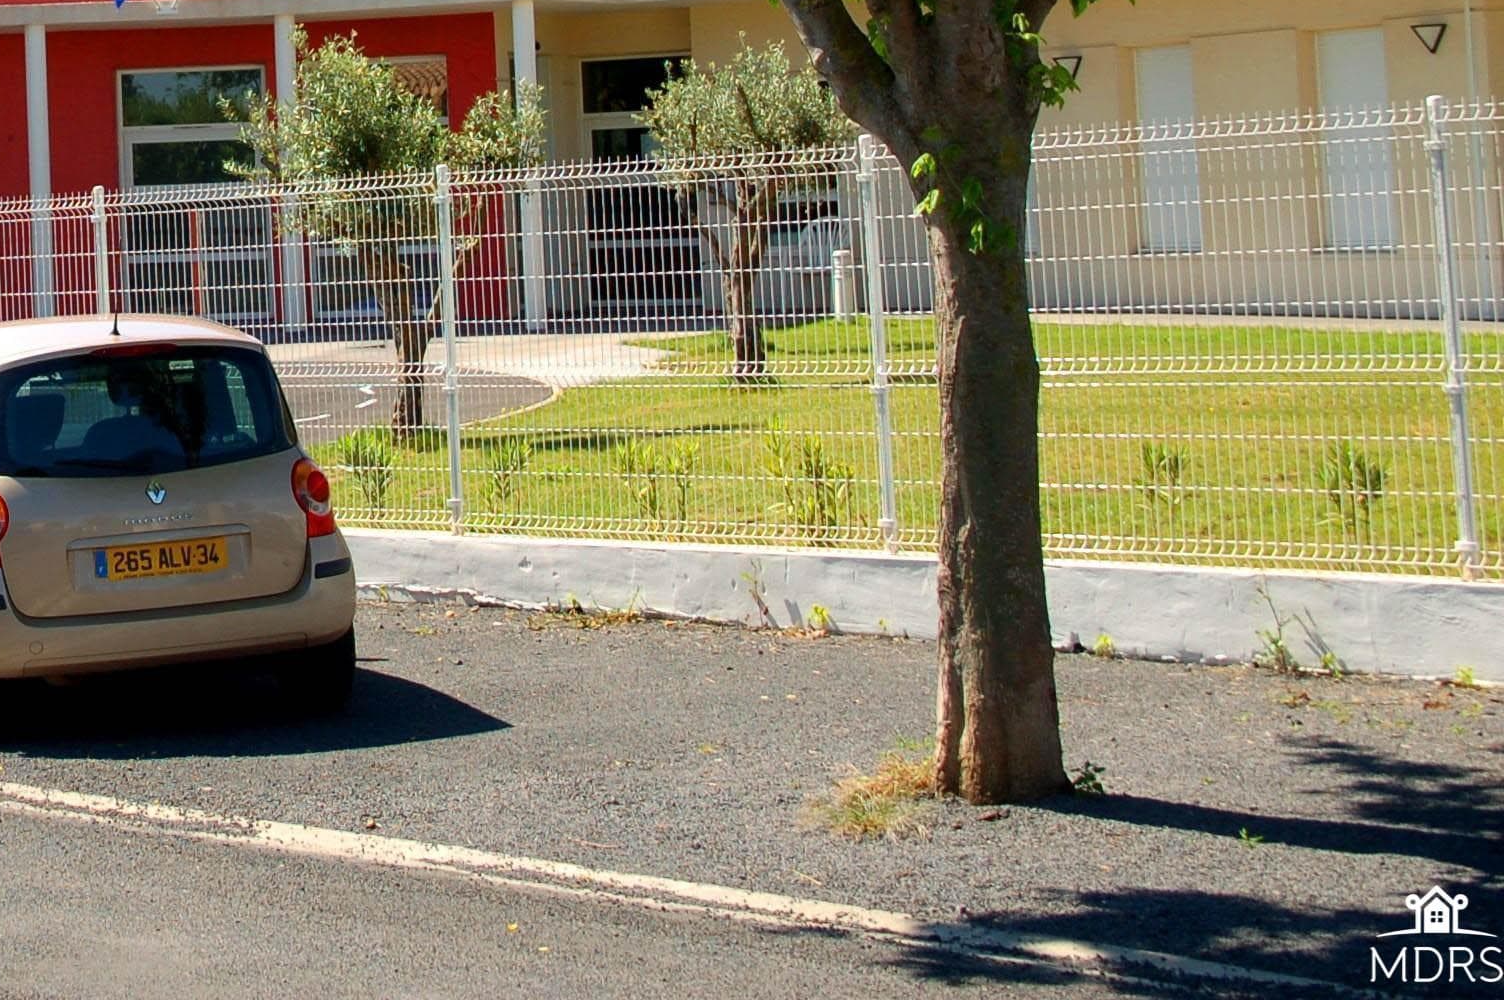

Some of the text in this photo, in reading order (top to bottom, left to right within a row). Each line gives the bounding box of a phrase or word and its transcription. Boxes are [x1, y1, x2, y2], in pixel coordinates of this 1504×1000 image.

[113, 543, 219, 573] 265 ALV 34
